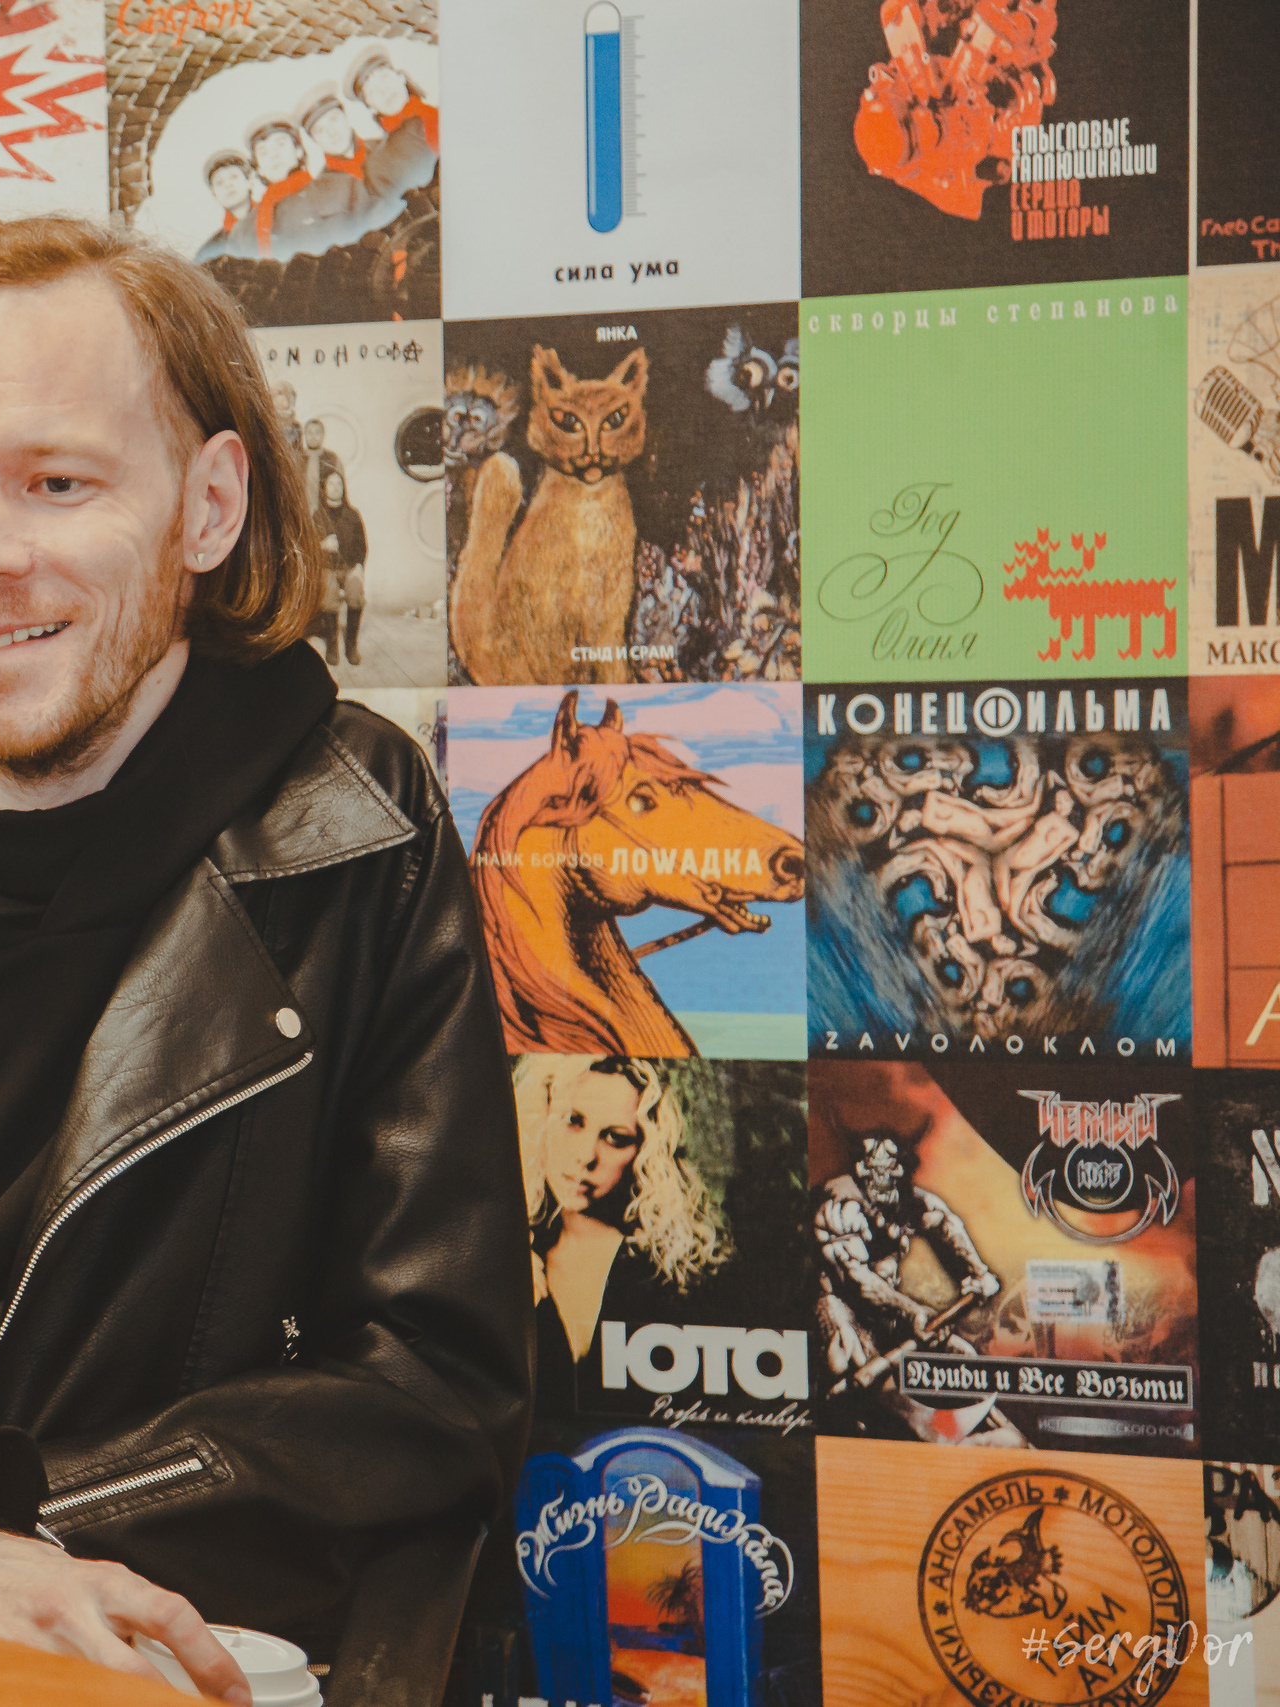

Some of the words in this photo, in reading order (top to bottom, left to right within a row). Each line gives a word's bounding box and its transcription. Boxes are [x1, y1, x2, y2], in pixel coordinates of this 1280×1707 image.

[1011, 117, 1130, 155] СМЫСЛОВЫЕ
[1011, 143, 1157, 183] ГАЛЛЮЦИНАЦИИ
[1010, 178, 1080, 211] СЕРДЦА
[1027, 205, 1110, 240] МОТОРЫ
[555, 264, 614, 283] сила
[630, 259, 680, 284] ума
[808, 304, 957, 336] скворцы
[987, 290, 1179, 324] степанова
[596, 324, 638, 343] ЯНКА
[871, 606, 979, 662] Оленя
[570, 646, 612, 662] СТЫД
[616, 646, 627, 661] И
[630, 644, 674, 661] СРАМ
[531, 852, 604, 868] БОРЗОВ
[927, 1477, 1046, 1592] АНСАМБЛЬ
